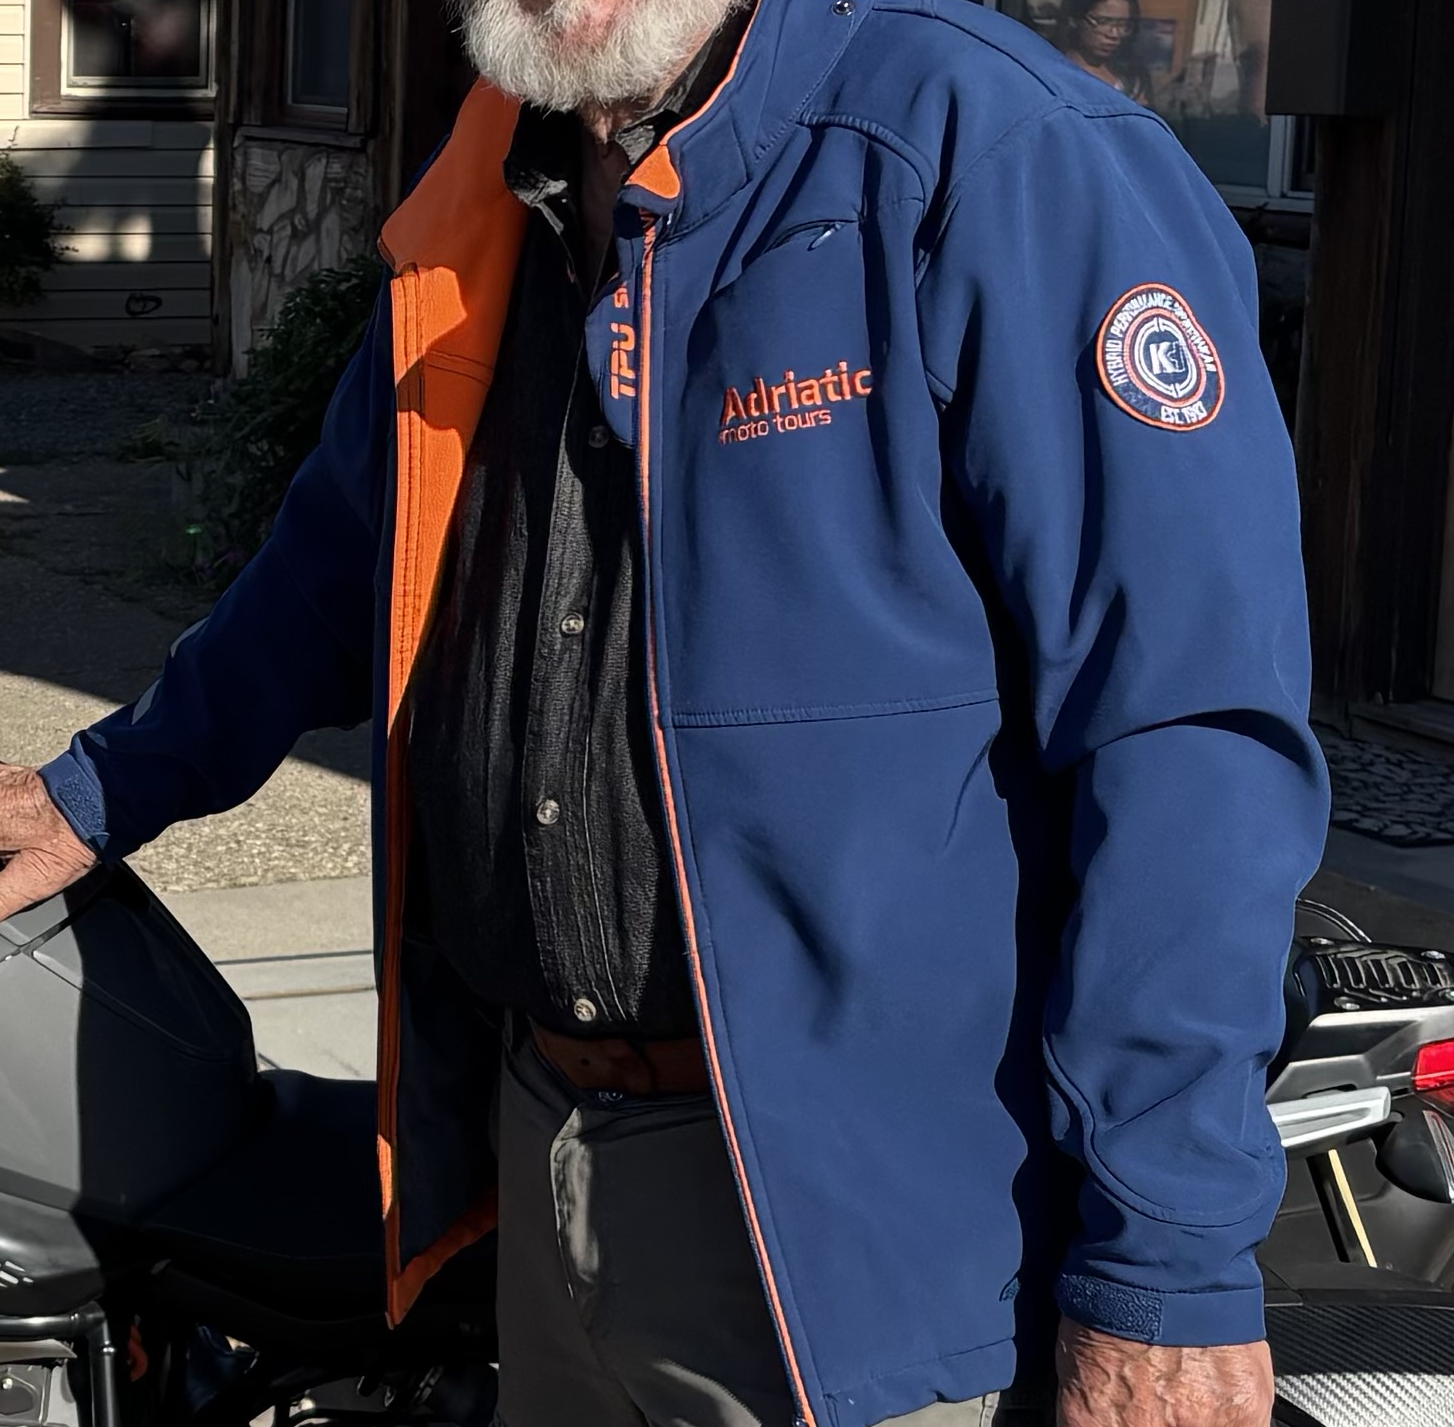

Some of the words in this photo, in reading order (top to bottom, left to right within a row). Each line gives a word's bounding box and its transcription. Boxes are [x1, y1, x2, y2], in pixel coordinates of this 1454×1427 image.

[610, 322, 636, 400] TPU
[720, 360, 873, 427] Adriatic
[718, 419, 769, 445] moto
[773, 408, 831, 433] tours
